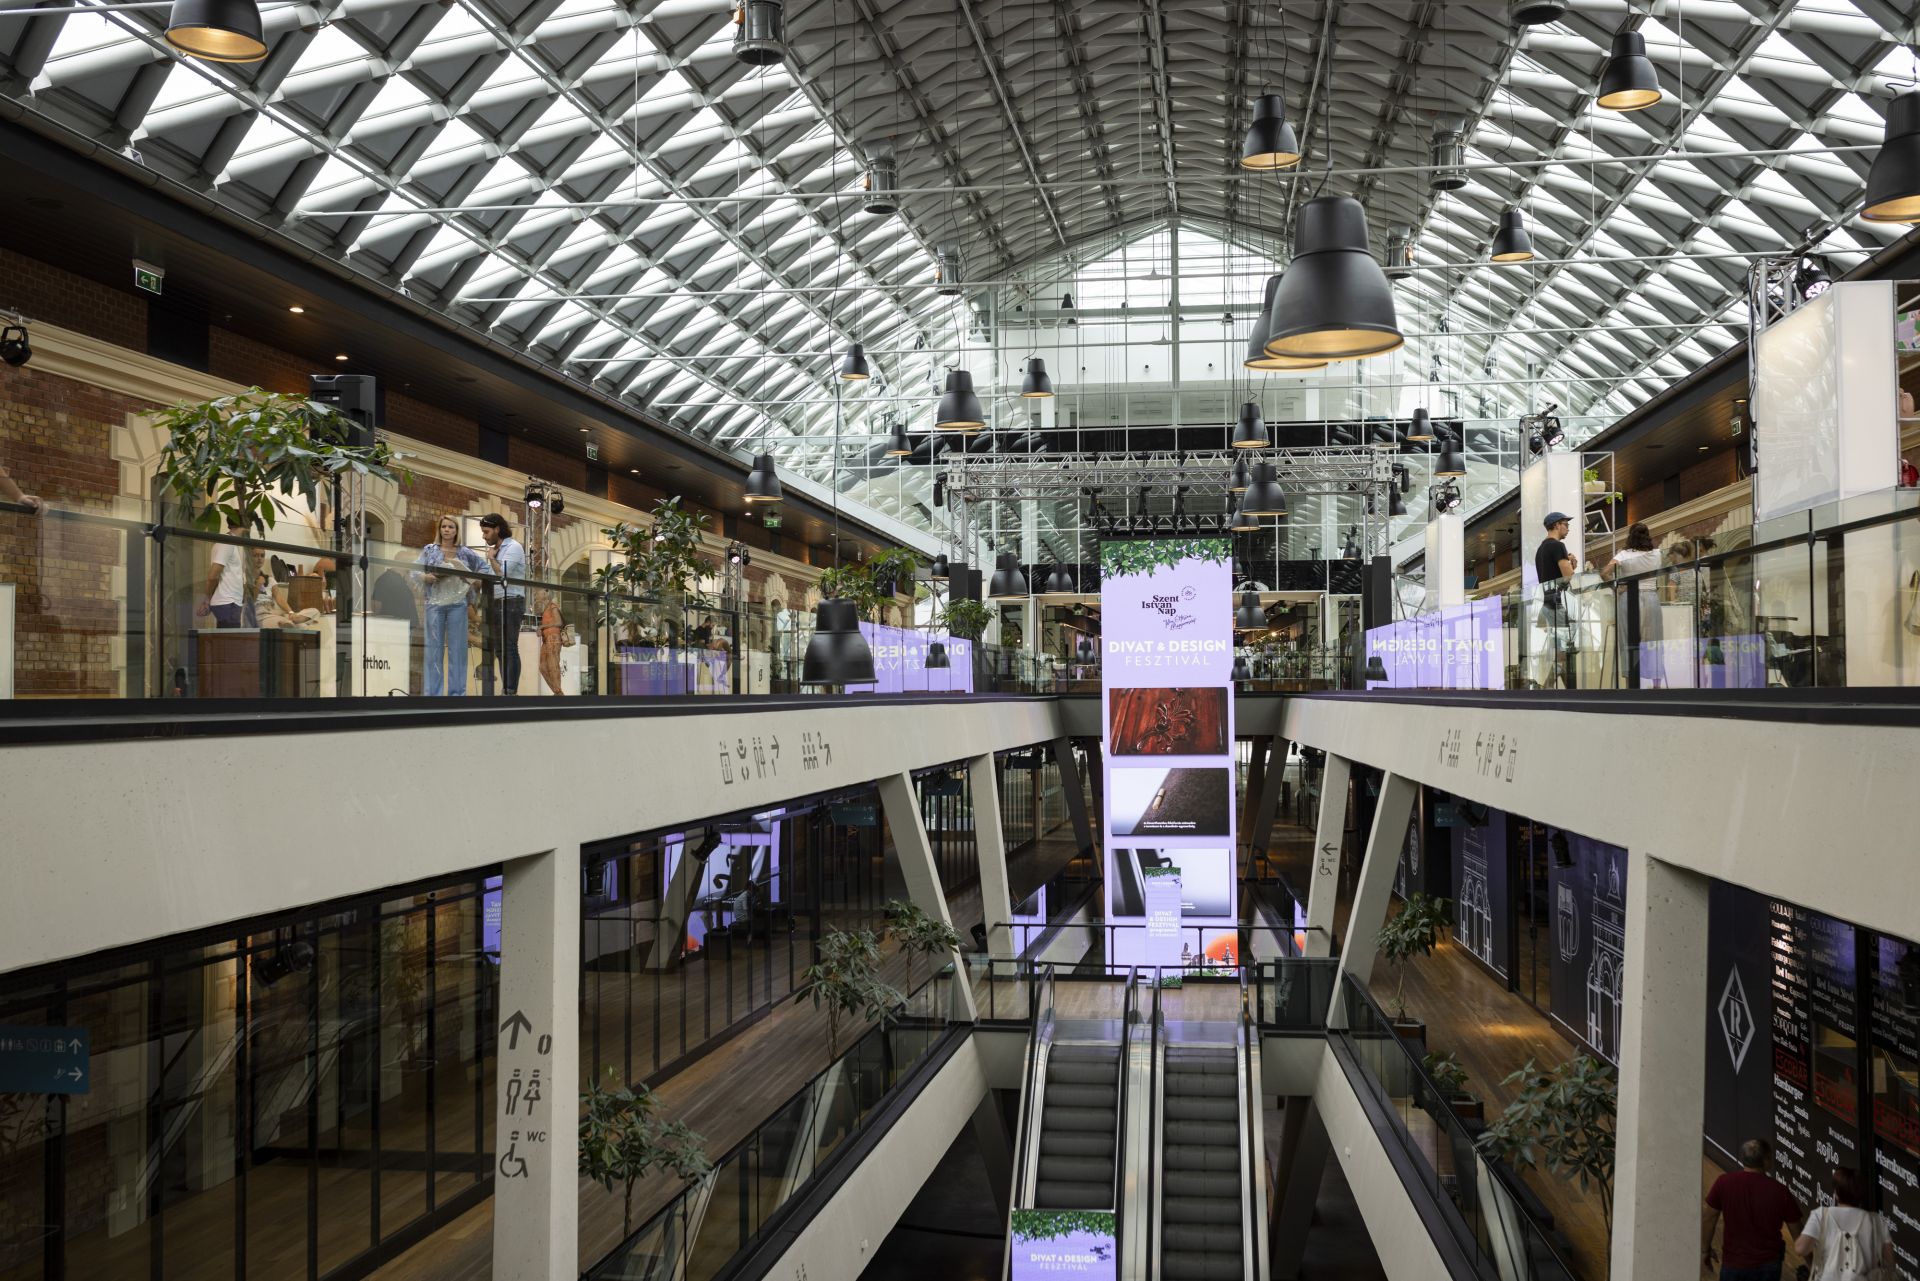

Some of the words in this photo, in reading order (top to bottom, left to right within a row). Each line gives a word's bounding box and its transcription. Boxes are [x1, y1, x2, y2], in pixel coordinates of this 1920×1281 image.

[1152, 595, 1179, 603] Szent
[1157, 607, 1176, 616] Nap
[1108, 641, 1154, 653] DIVAT
[1157, 642, 1166, 652] &
[1169, 640, 1226, 652] DESIGN
[1125, 653, 1211, 666] FESZTIVÁL
[1774, 1073, 1804, 1101] Hamburger
[527, 1131, 546, 1142] WC
[1031, 1253, 1056, 1262] DIVAT
[1064, 1254, 1098, 1264] DESIGN
